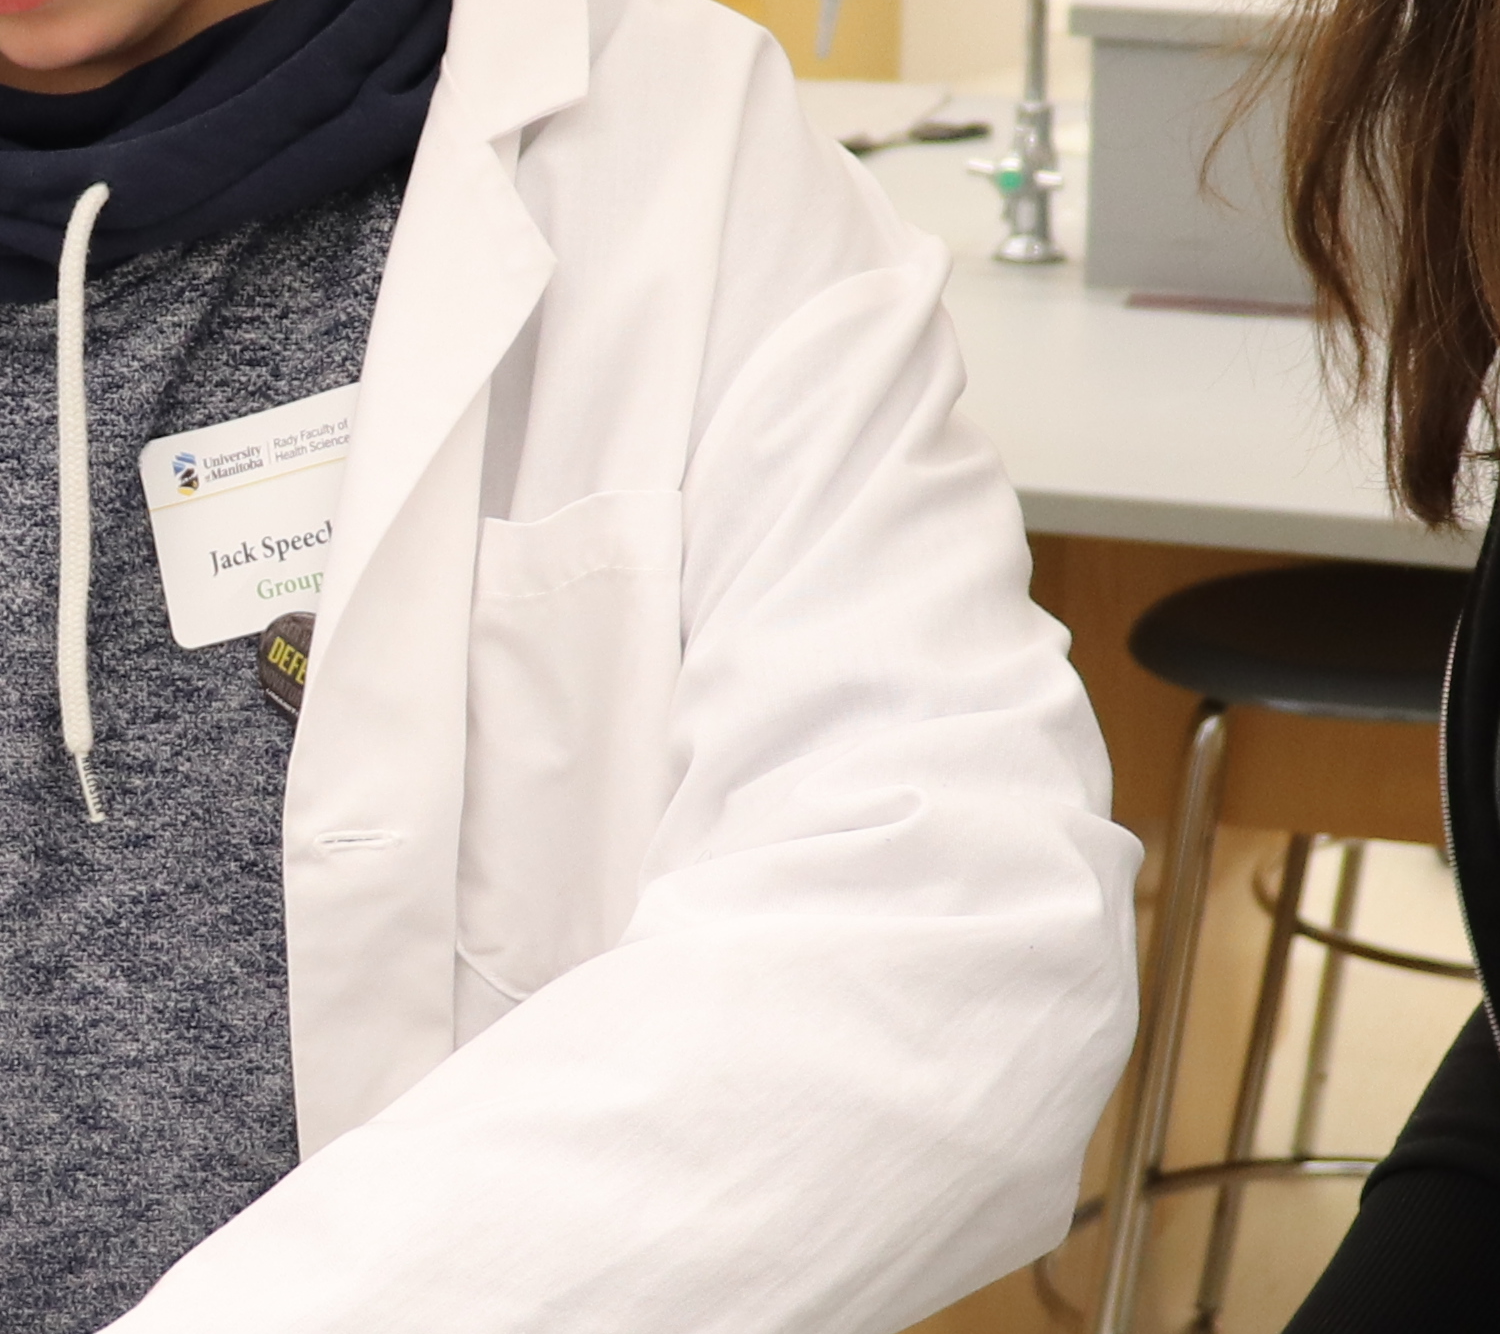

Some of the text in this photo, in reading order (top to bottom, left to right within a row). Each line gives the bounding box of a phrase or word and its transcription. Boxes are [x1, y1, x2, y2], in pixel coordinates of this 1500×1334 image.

[273, 418, 349, 450] Rady Faculty of
[202, 444, 263, 470] University
[275, 446, 308, 463] Health
[211, 458, 264, 482] Manitoba
[209, 541, 258, 577] Jack
